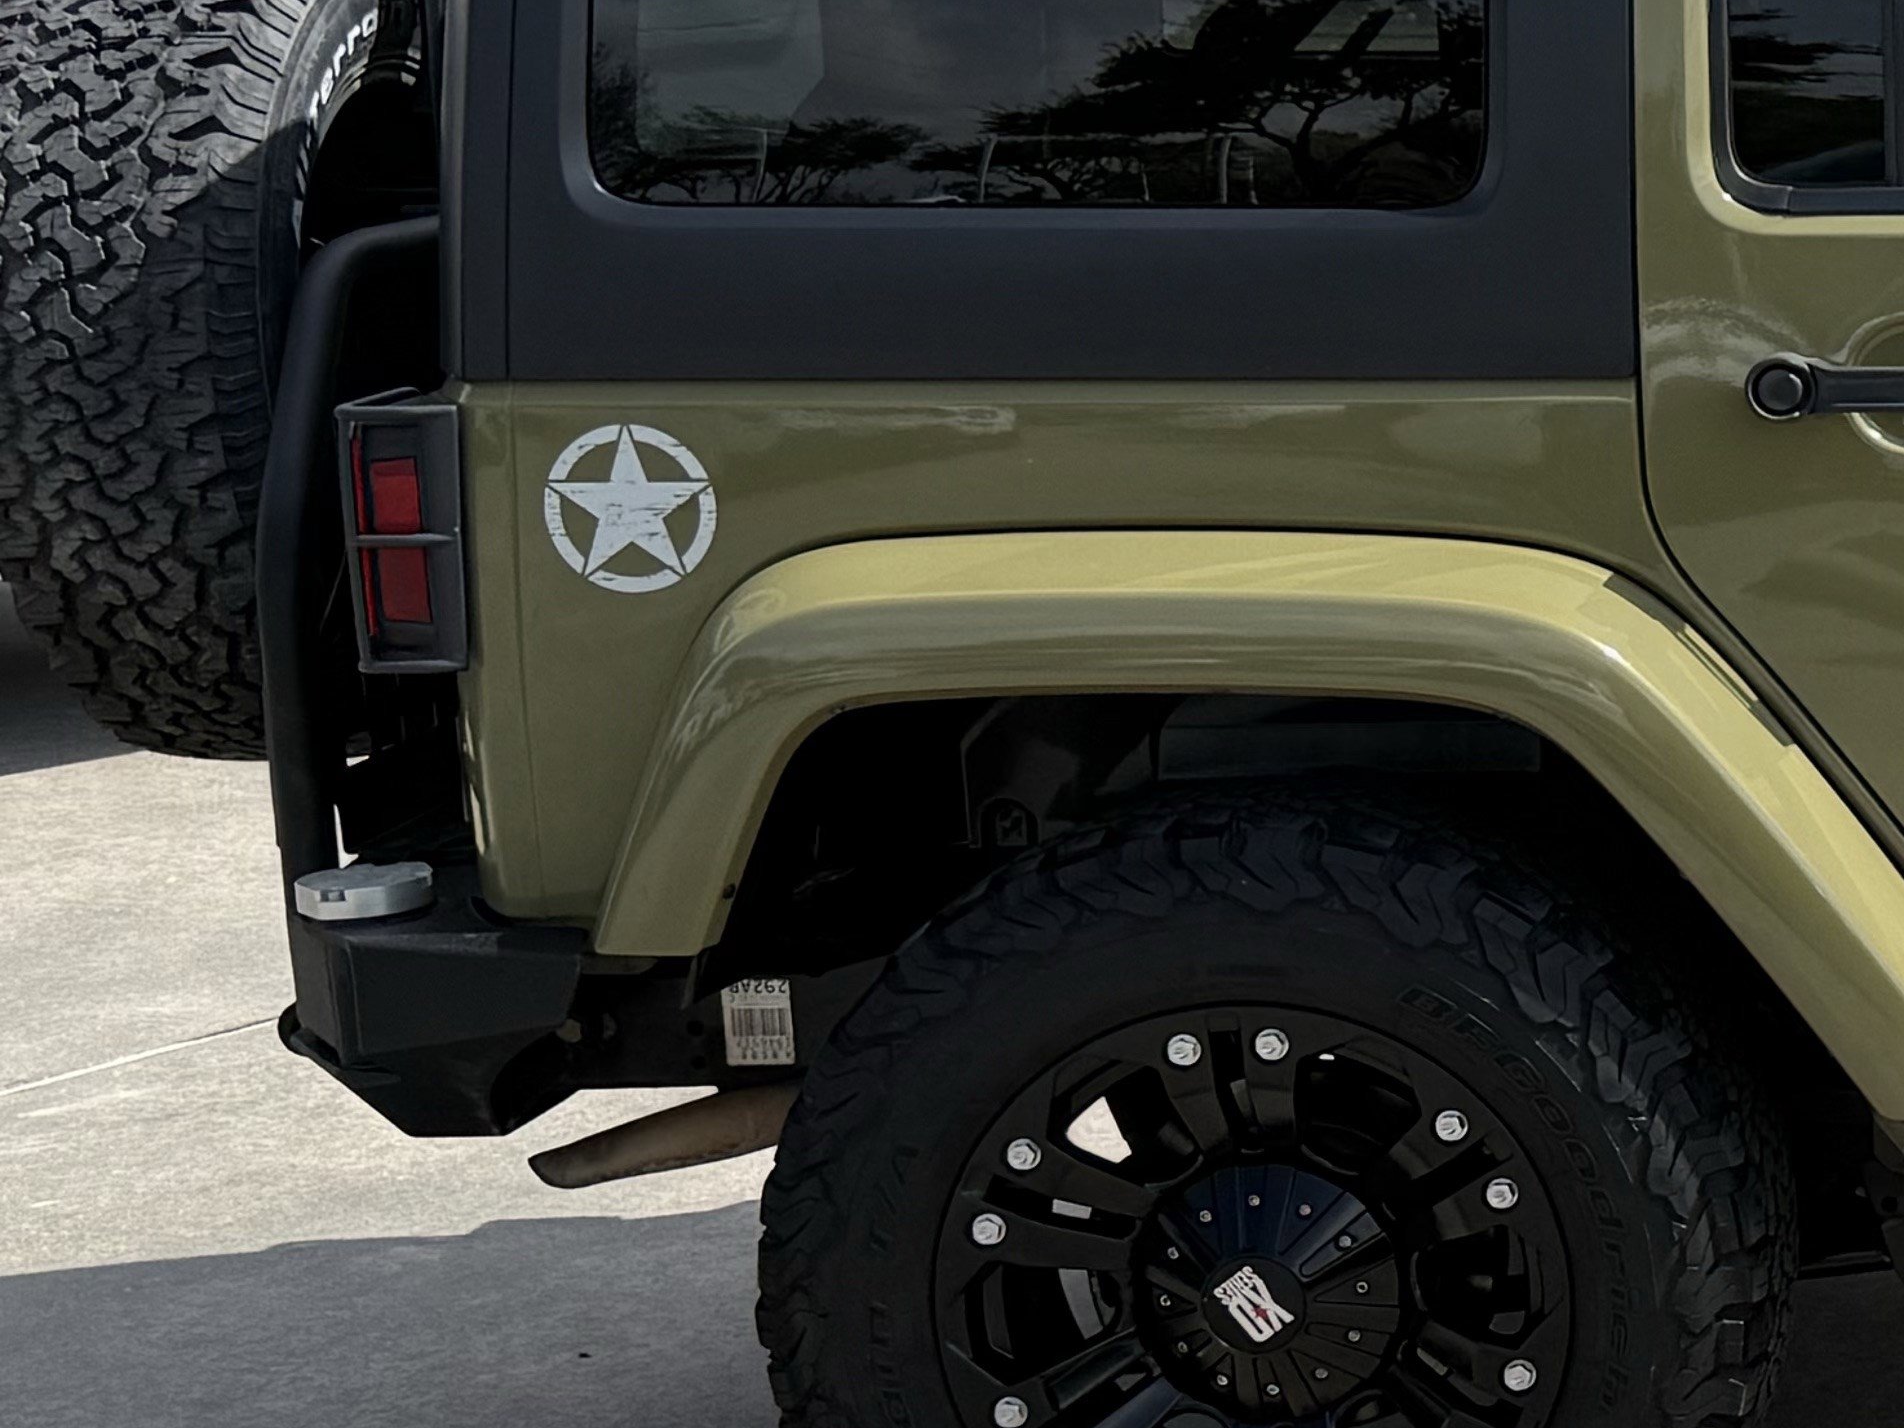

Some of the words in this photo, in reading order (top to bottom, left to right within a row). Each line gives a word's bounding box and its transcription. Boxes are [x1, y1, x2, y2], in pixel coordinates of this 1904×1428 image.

[1398, 985, 1629, 1412] BFGoodrich
[1213, 1265, 1254, 1306] SERIES
[1228, 1272, 1296, 1343] XD
